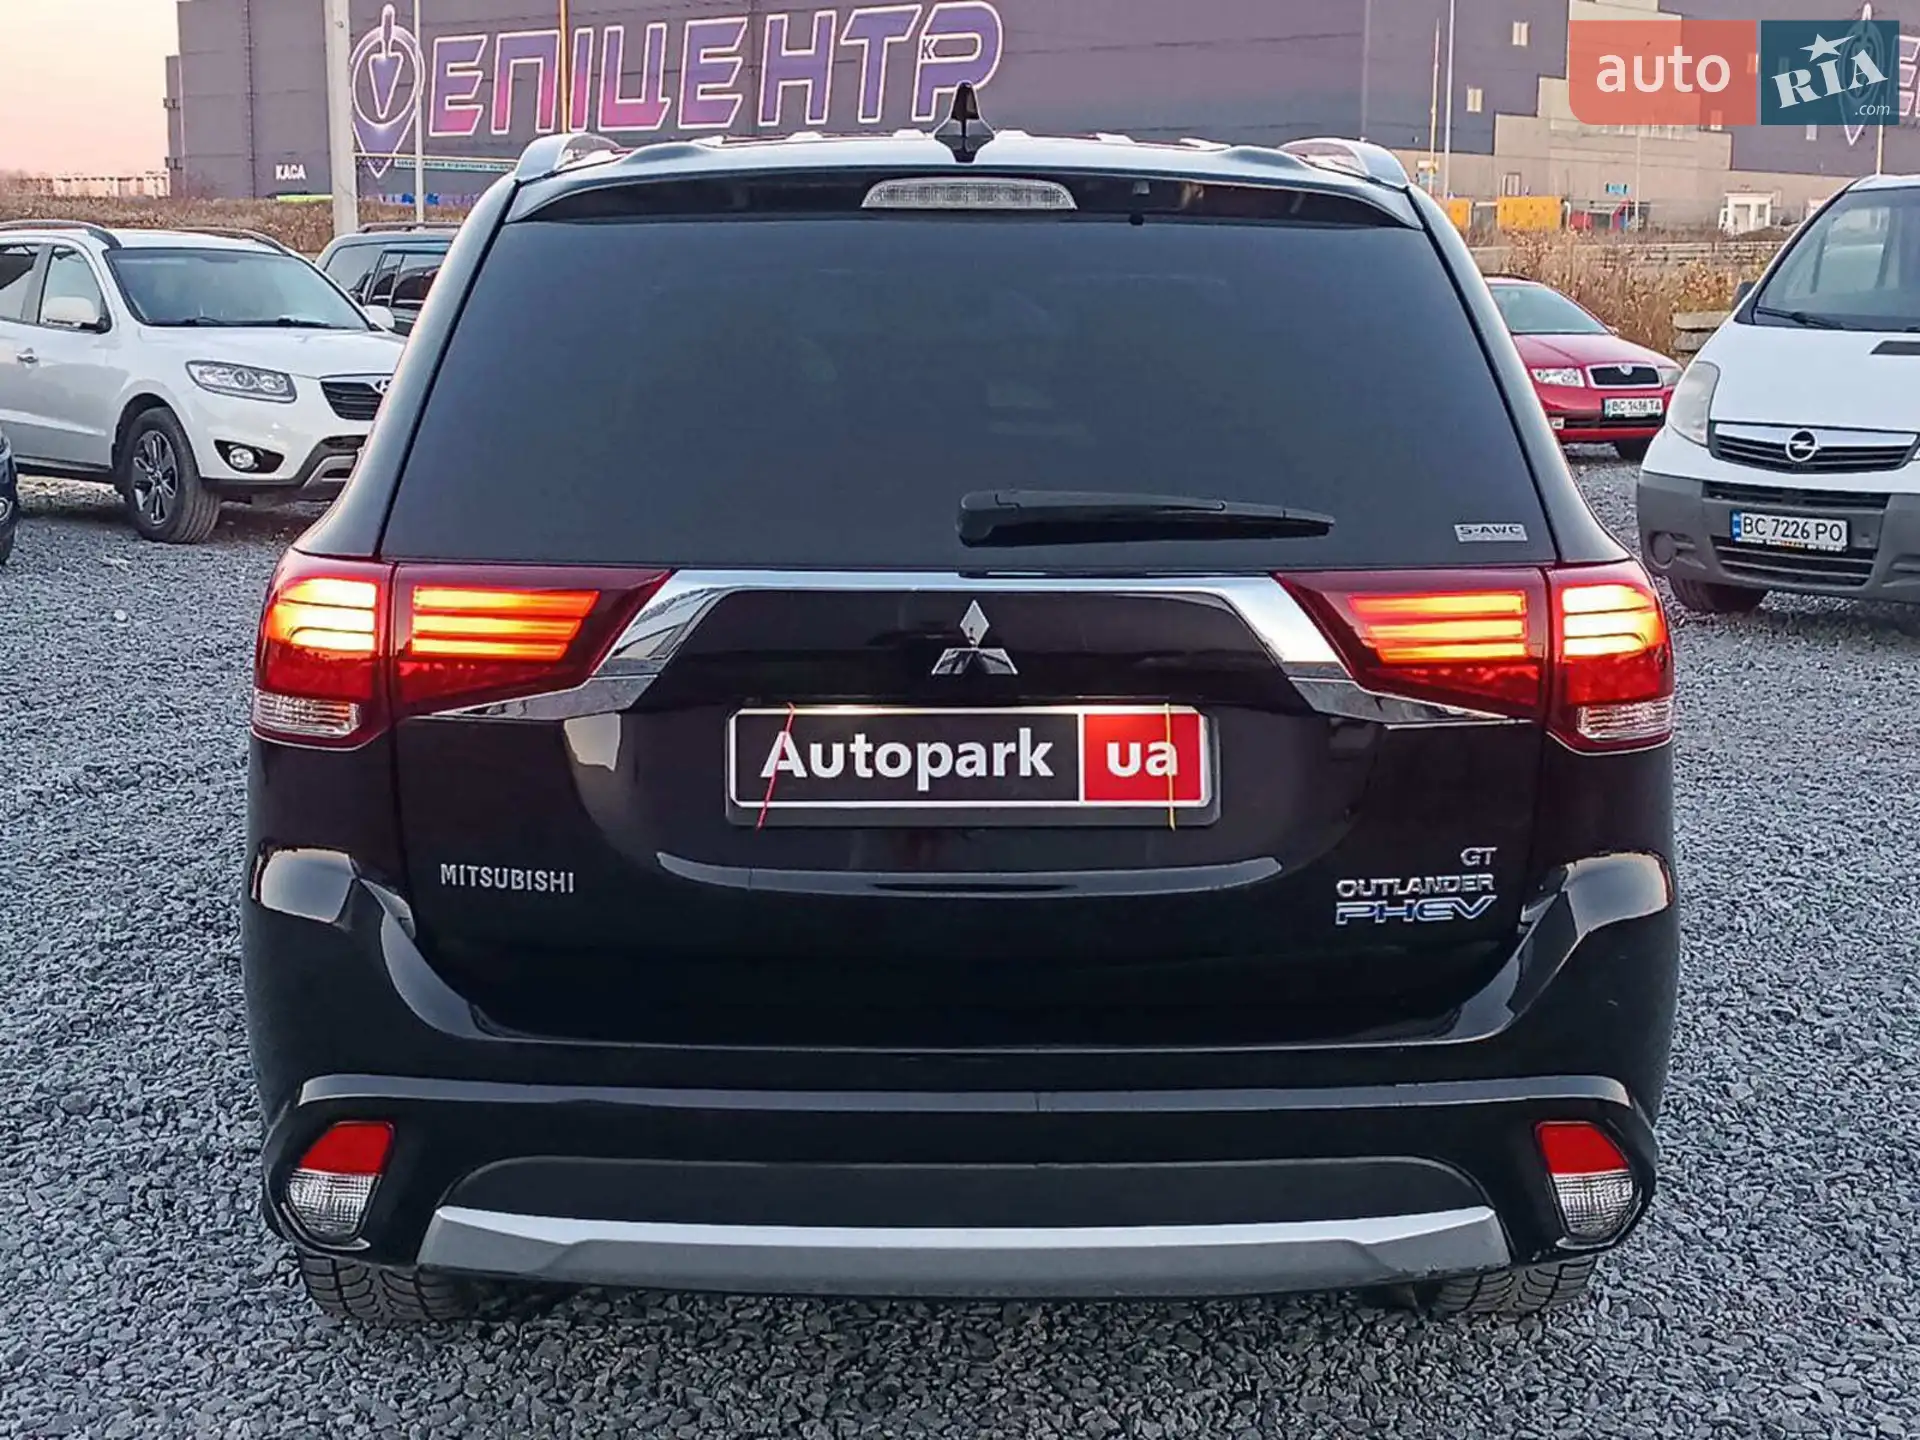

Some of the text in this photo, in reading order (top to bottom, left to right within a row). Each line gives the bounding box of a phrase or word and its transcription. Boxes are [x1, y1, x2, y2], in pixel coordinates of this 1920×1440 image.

[428, 1, 1003, 136] ЕПІЦЕНТР
[275, 163, 306, 180] КАСА
[1459, 525, 1521, 535] S-AWC
[1742, 516, 1843, 542] BC 7226 PO
[760, 727, 1178, 792] Autopark ua
[1460, 846, 1498, 867] GT
[440, 863, 574, 894] MITSUBISHI
[1336, 873, 1495, 898] OUTLANDER
[1335, 895, 1498, 926] PHEV
